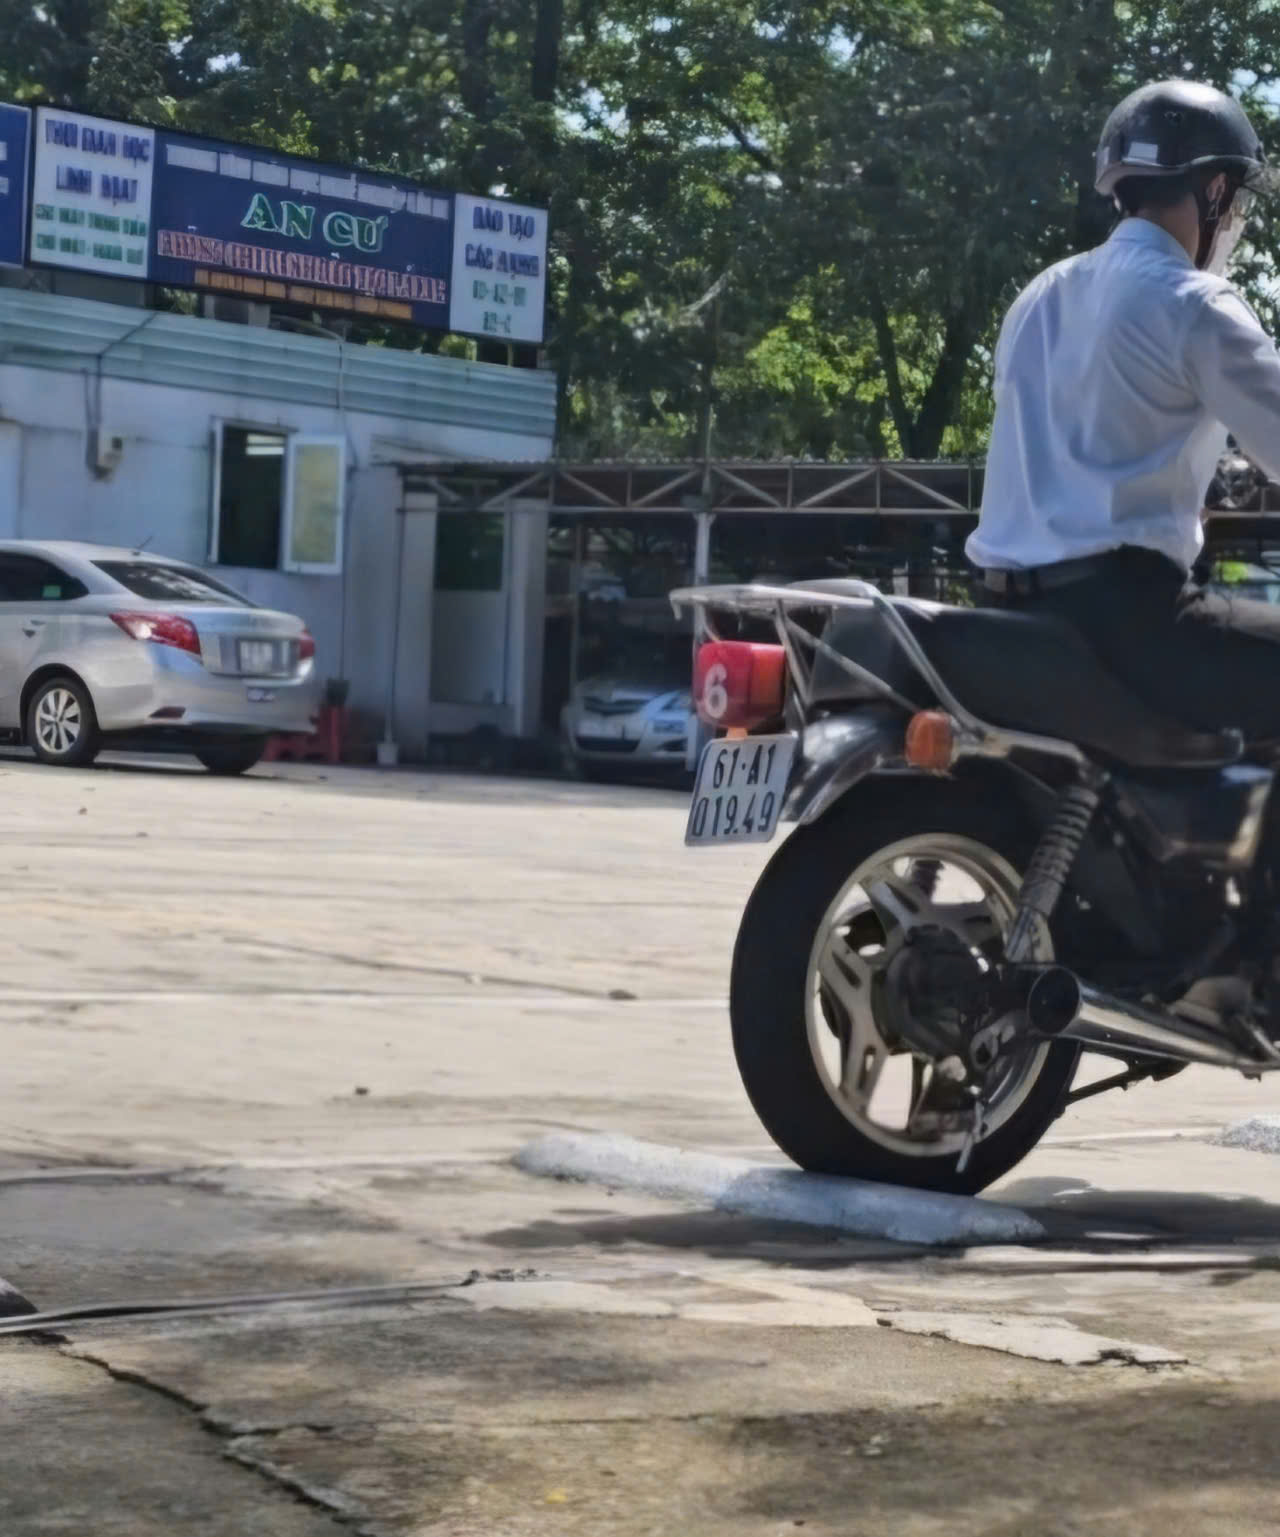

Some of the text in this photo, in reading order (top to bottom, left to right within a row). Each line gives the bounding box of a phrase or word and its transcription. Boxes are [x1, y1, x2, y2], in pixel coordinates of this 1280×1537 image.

[240, 193, 316, 240] AN
[323, 211, 389, 253] CƯ
[704, 663, 728, 719] 6
